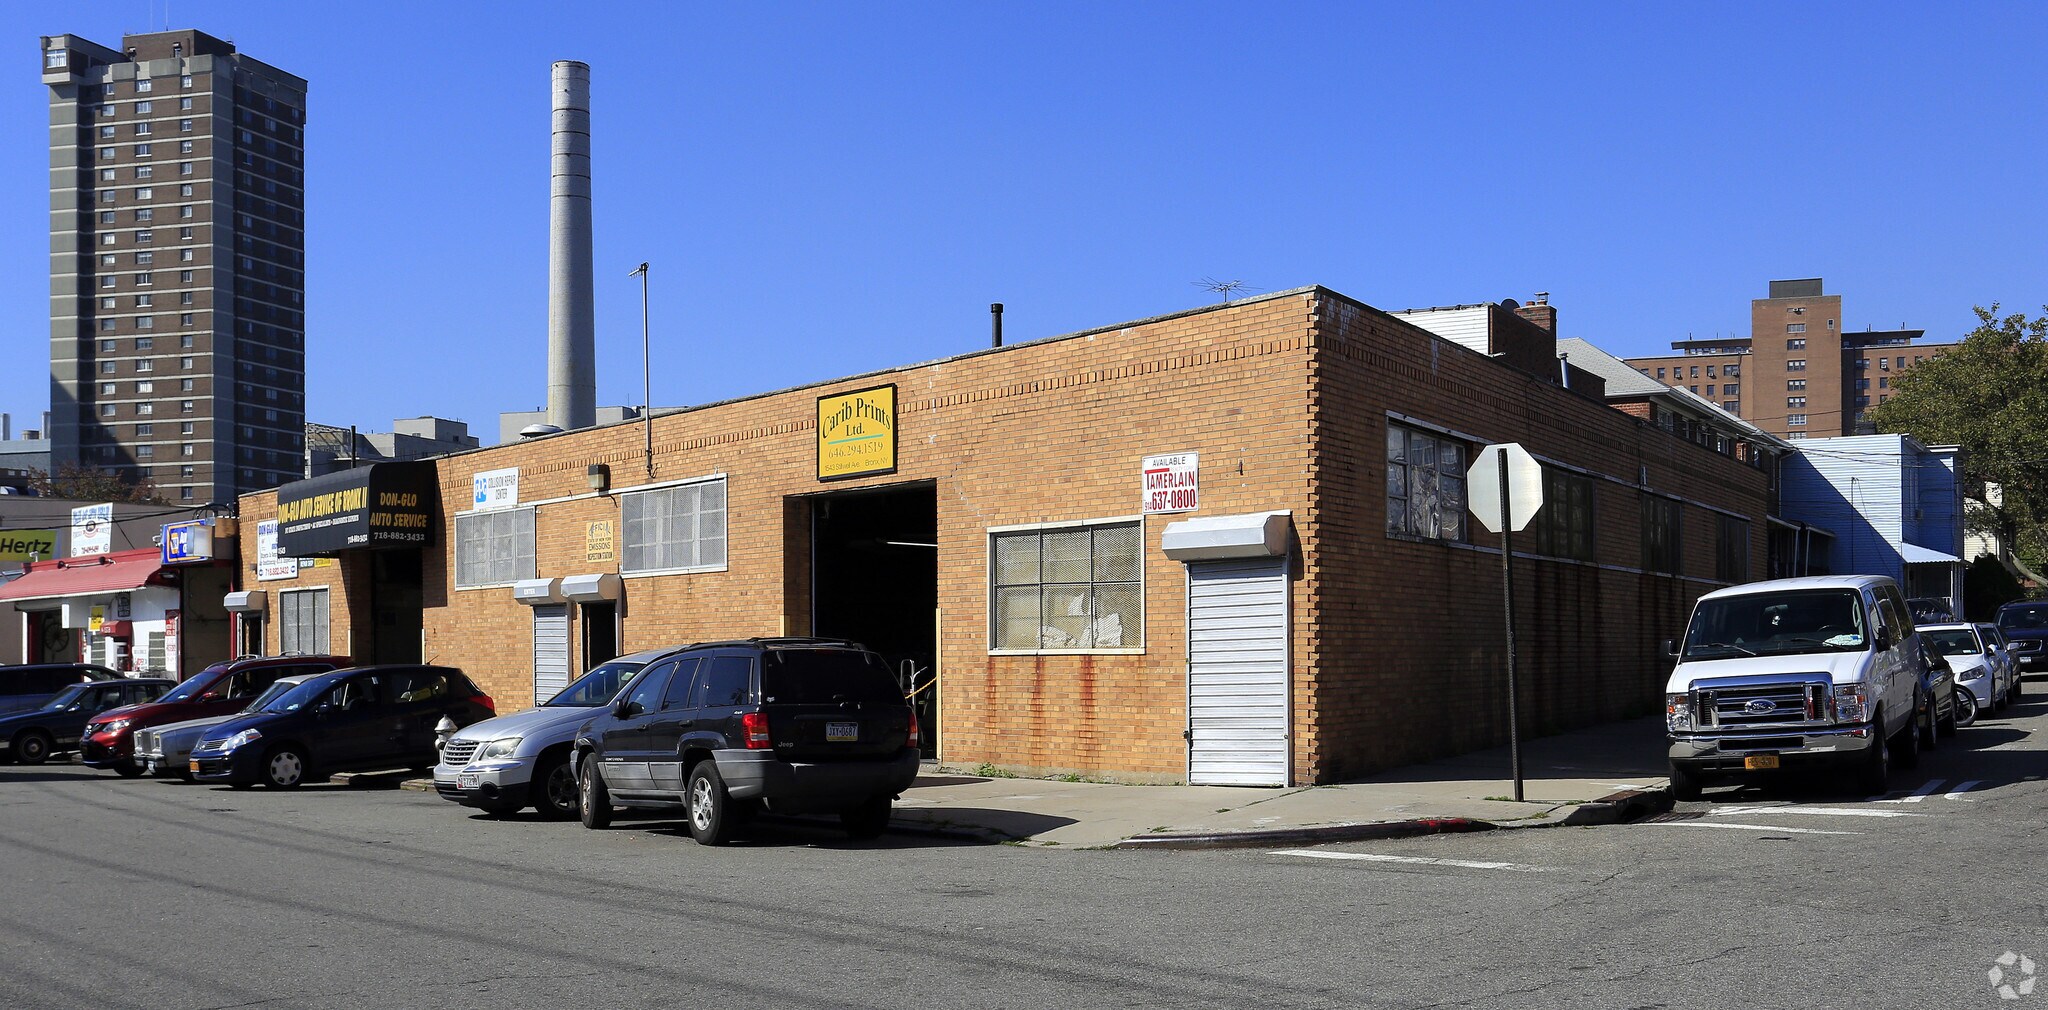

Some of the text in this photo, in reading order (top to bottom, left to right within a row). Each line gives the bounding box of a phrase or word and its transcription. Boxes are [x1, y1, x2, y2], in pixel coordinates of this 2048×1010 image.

[823, 398, 891, 438] Carib Prints
[846, 423, 865, 436] Ltd.
[828, 442, 884, 458] 646.294.1519
[1152, 456, 1186, 466] AVAILABLE
[1145, 468, 1195, 490] TAMERLAIN
[314, 493, 334, 517] SERVICE
[335, 492, 342, 512] OF
[380, 492, 417, 507] DON-GLO
[1152, 489, 1196, 510] 637-0800
[370, 512, 427, 528] AUTO SERVICE
[374, 532, 425, 541] 718-882-3432
[0, 538, 52, 554] Hertz
[589, 542, 610, 551] EMISSIONS
